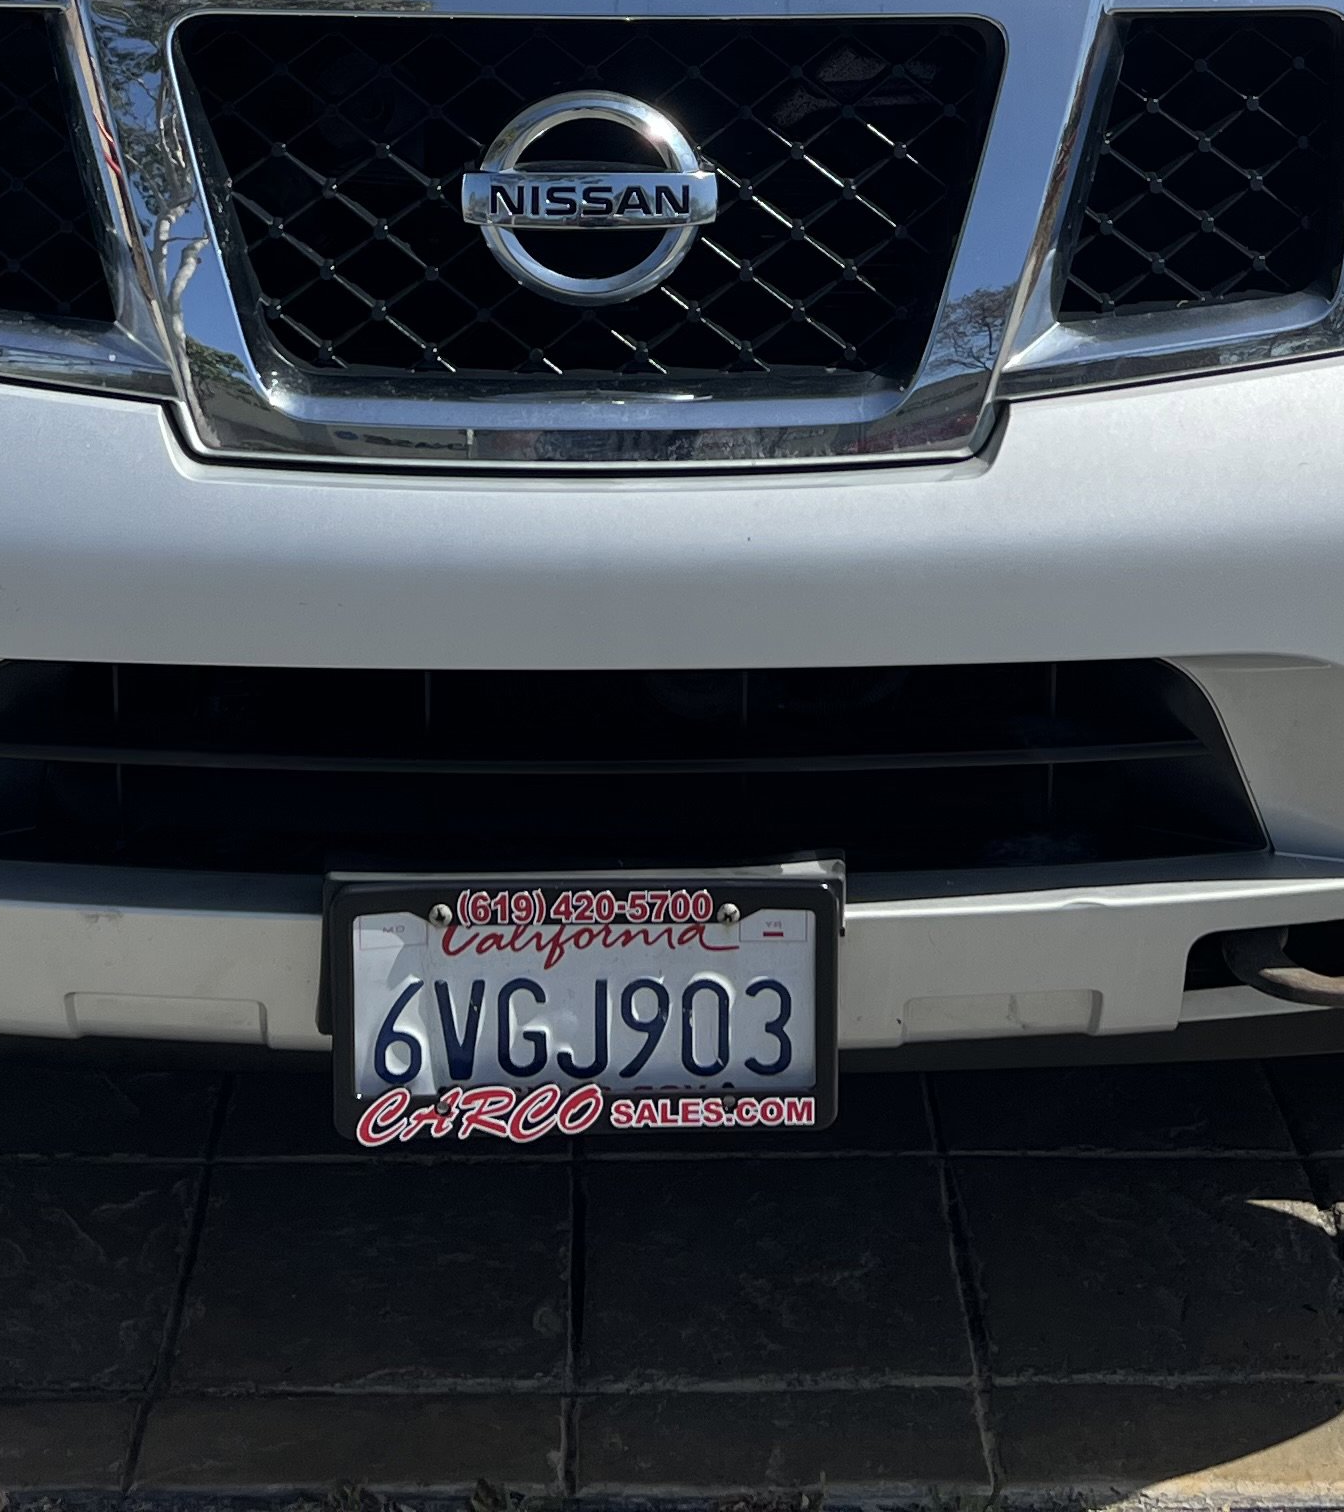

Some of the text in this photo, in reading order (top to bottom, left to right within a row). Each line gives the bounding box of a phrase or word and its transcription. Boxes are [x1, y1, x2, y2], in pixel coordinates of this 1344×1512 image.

[489, 183, 691, 217] NISSAN
[456, 889, 714, 927] (619) 420-5700
[440, 923, 740, 970] California
[373, 975, 793, 1086] 6VGJ903
[356, 1083, 816, 1148] CARCO SALES.COM
